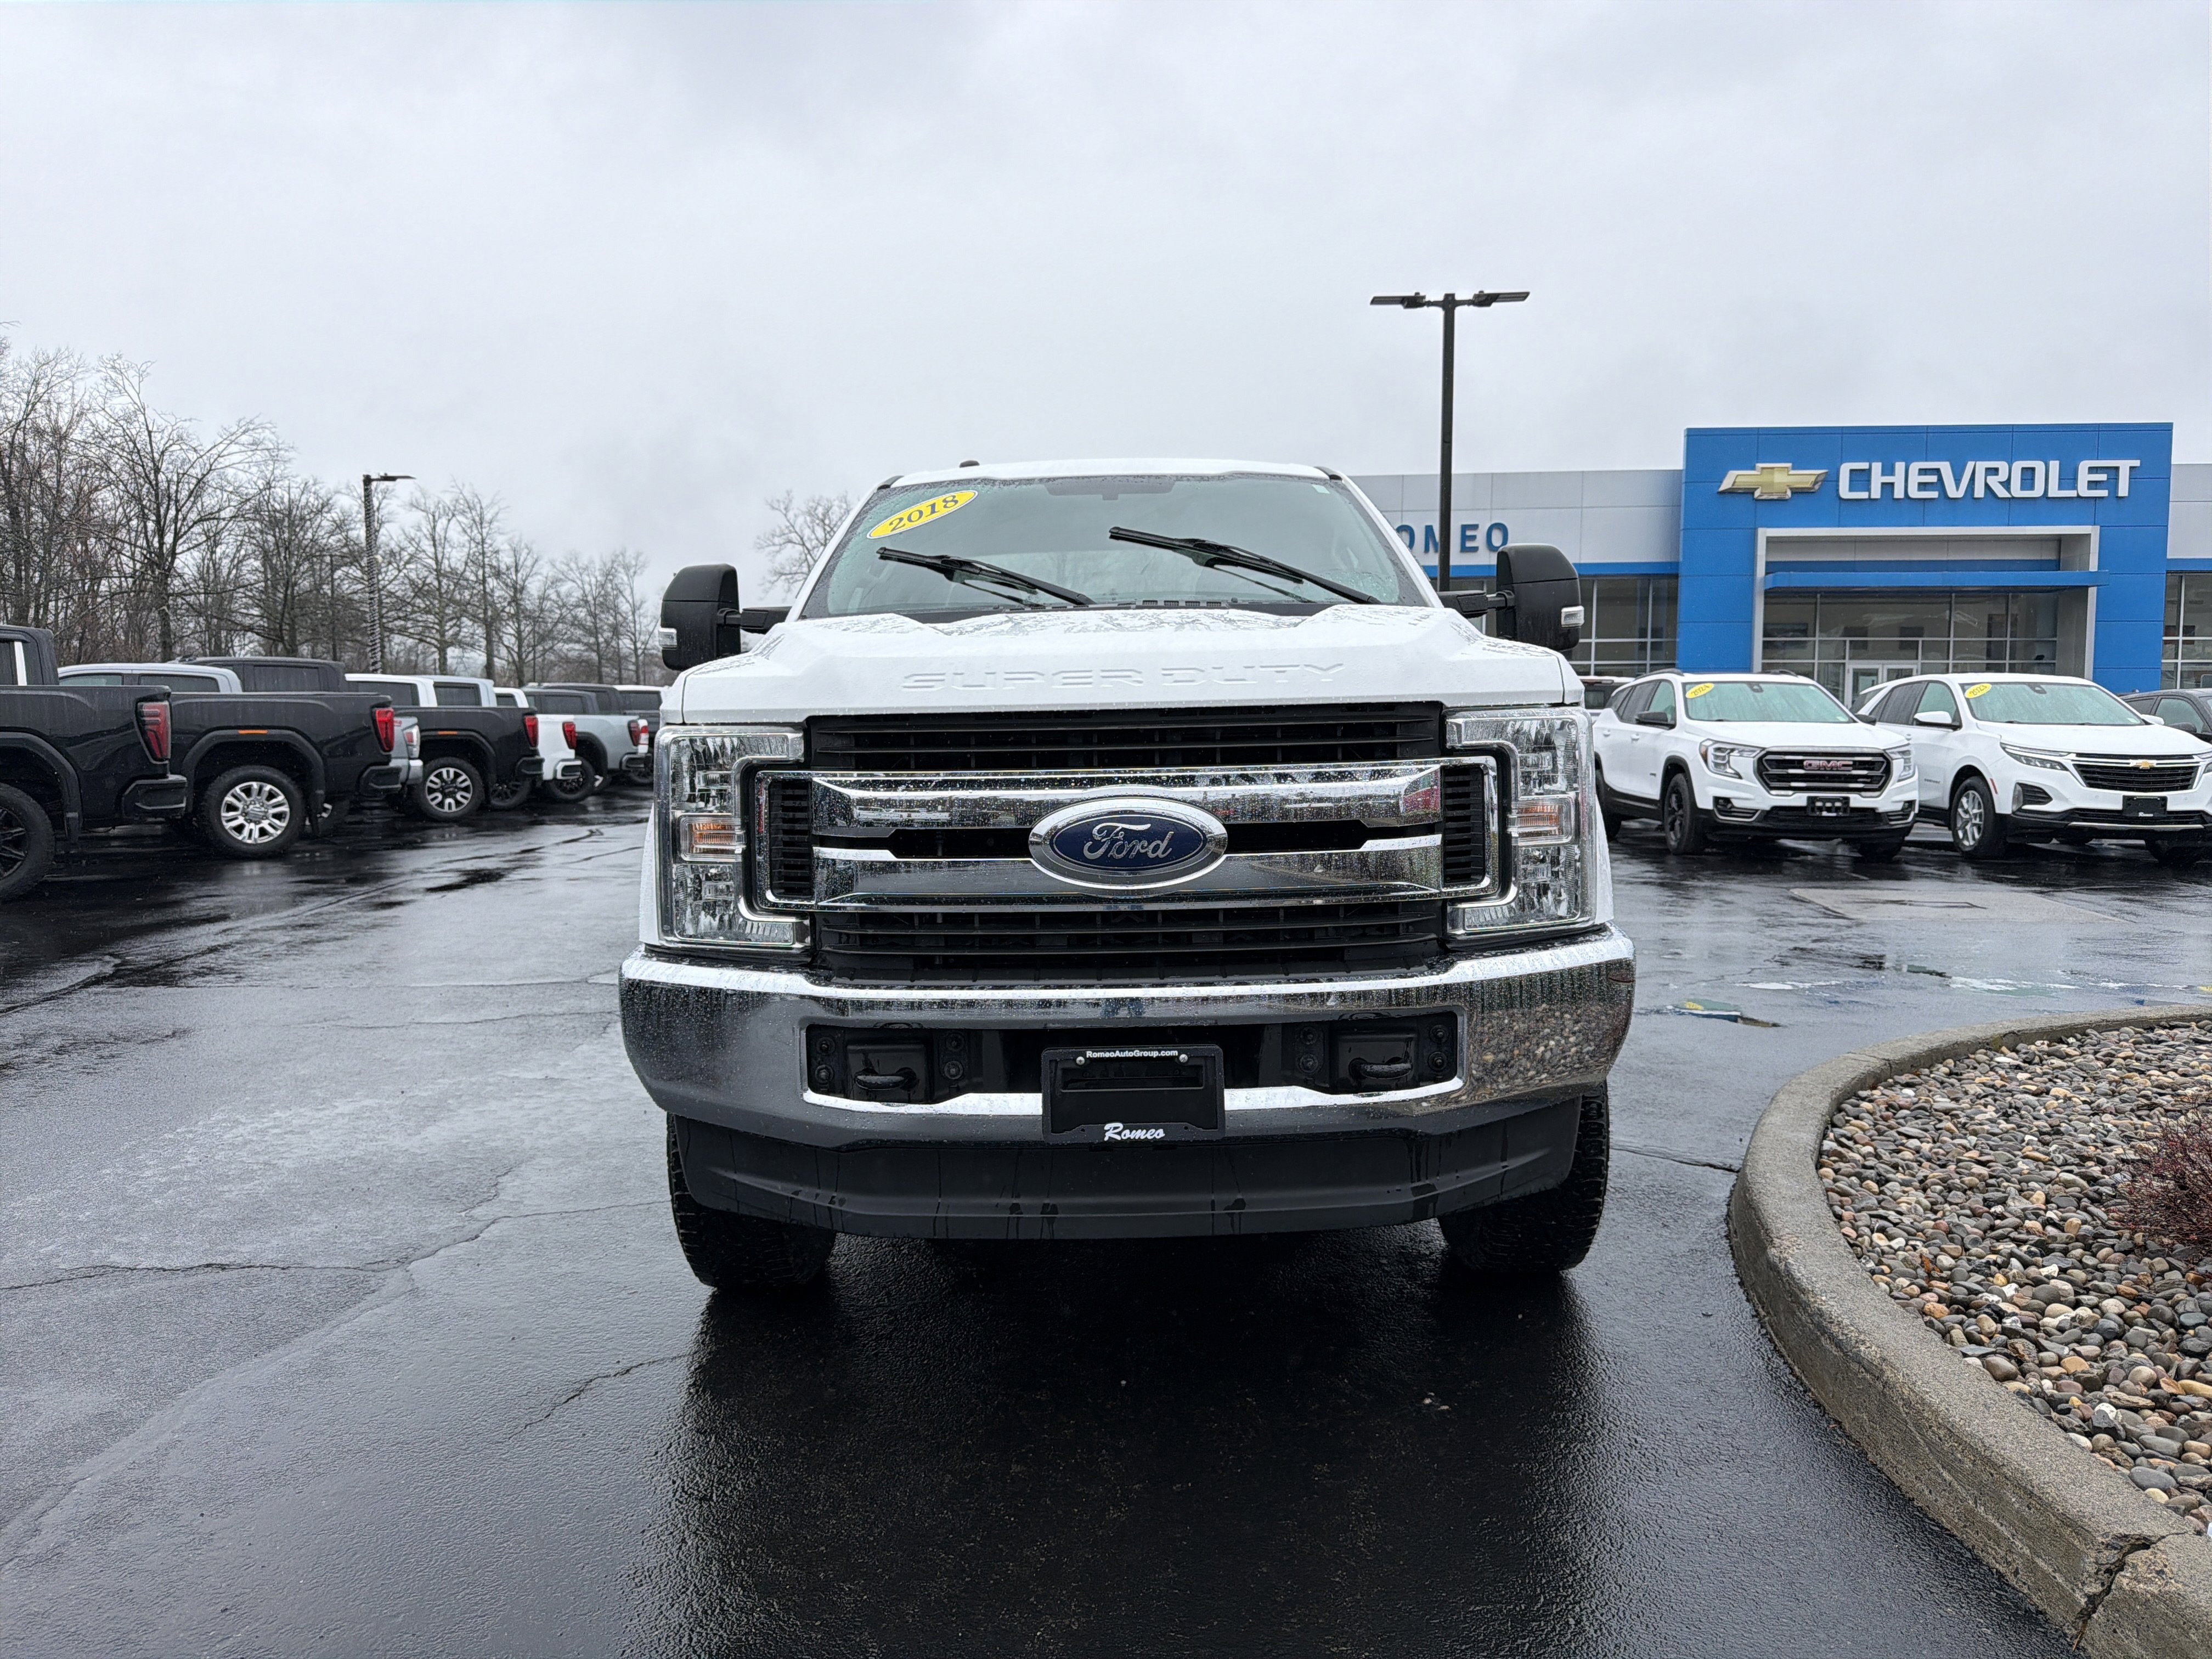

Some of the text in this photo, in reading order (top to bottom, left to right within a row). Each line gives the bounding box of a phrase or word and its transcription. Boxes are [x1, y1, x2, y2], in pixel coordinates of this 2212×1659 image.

[1839, 459, 2141, 499] CHEVROLET
[889, 495, 960, 532] 2018
[1395, 522, 1509, 554] OMEO
[902, 663, 1344, 691] SUPER DUTY
[1803, 760, 1853, 770] GMC
[1083, 822, 1174, 860] Ford
[1086, 1049, 1178, 1058] RomeoAutoGroup.com
[1104, 1122, 1165, 1141] Romeo
